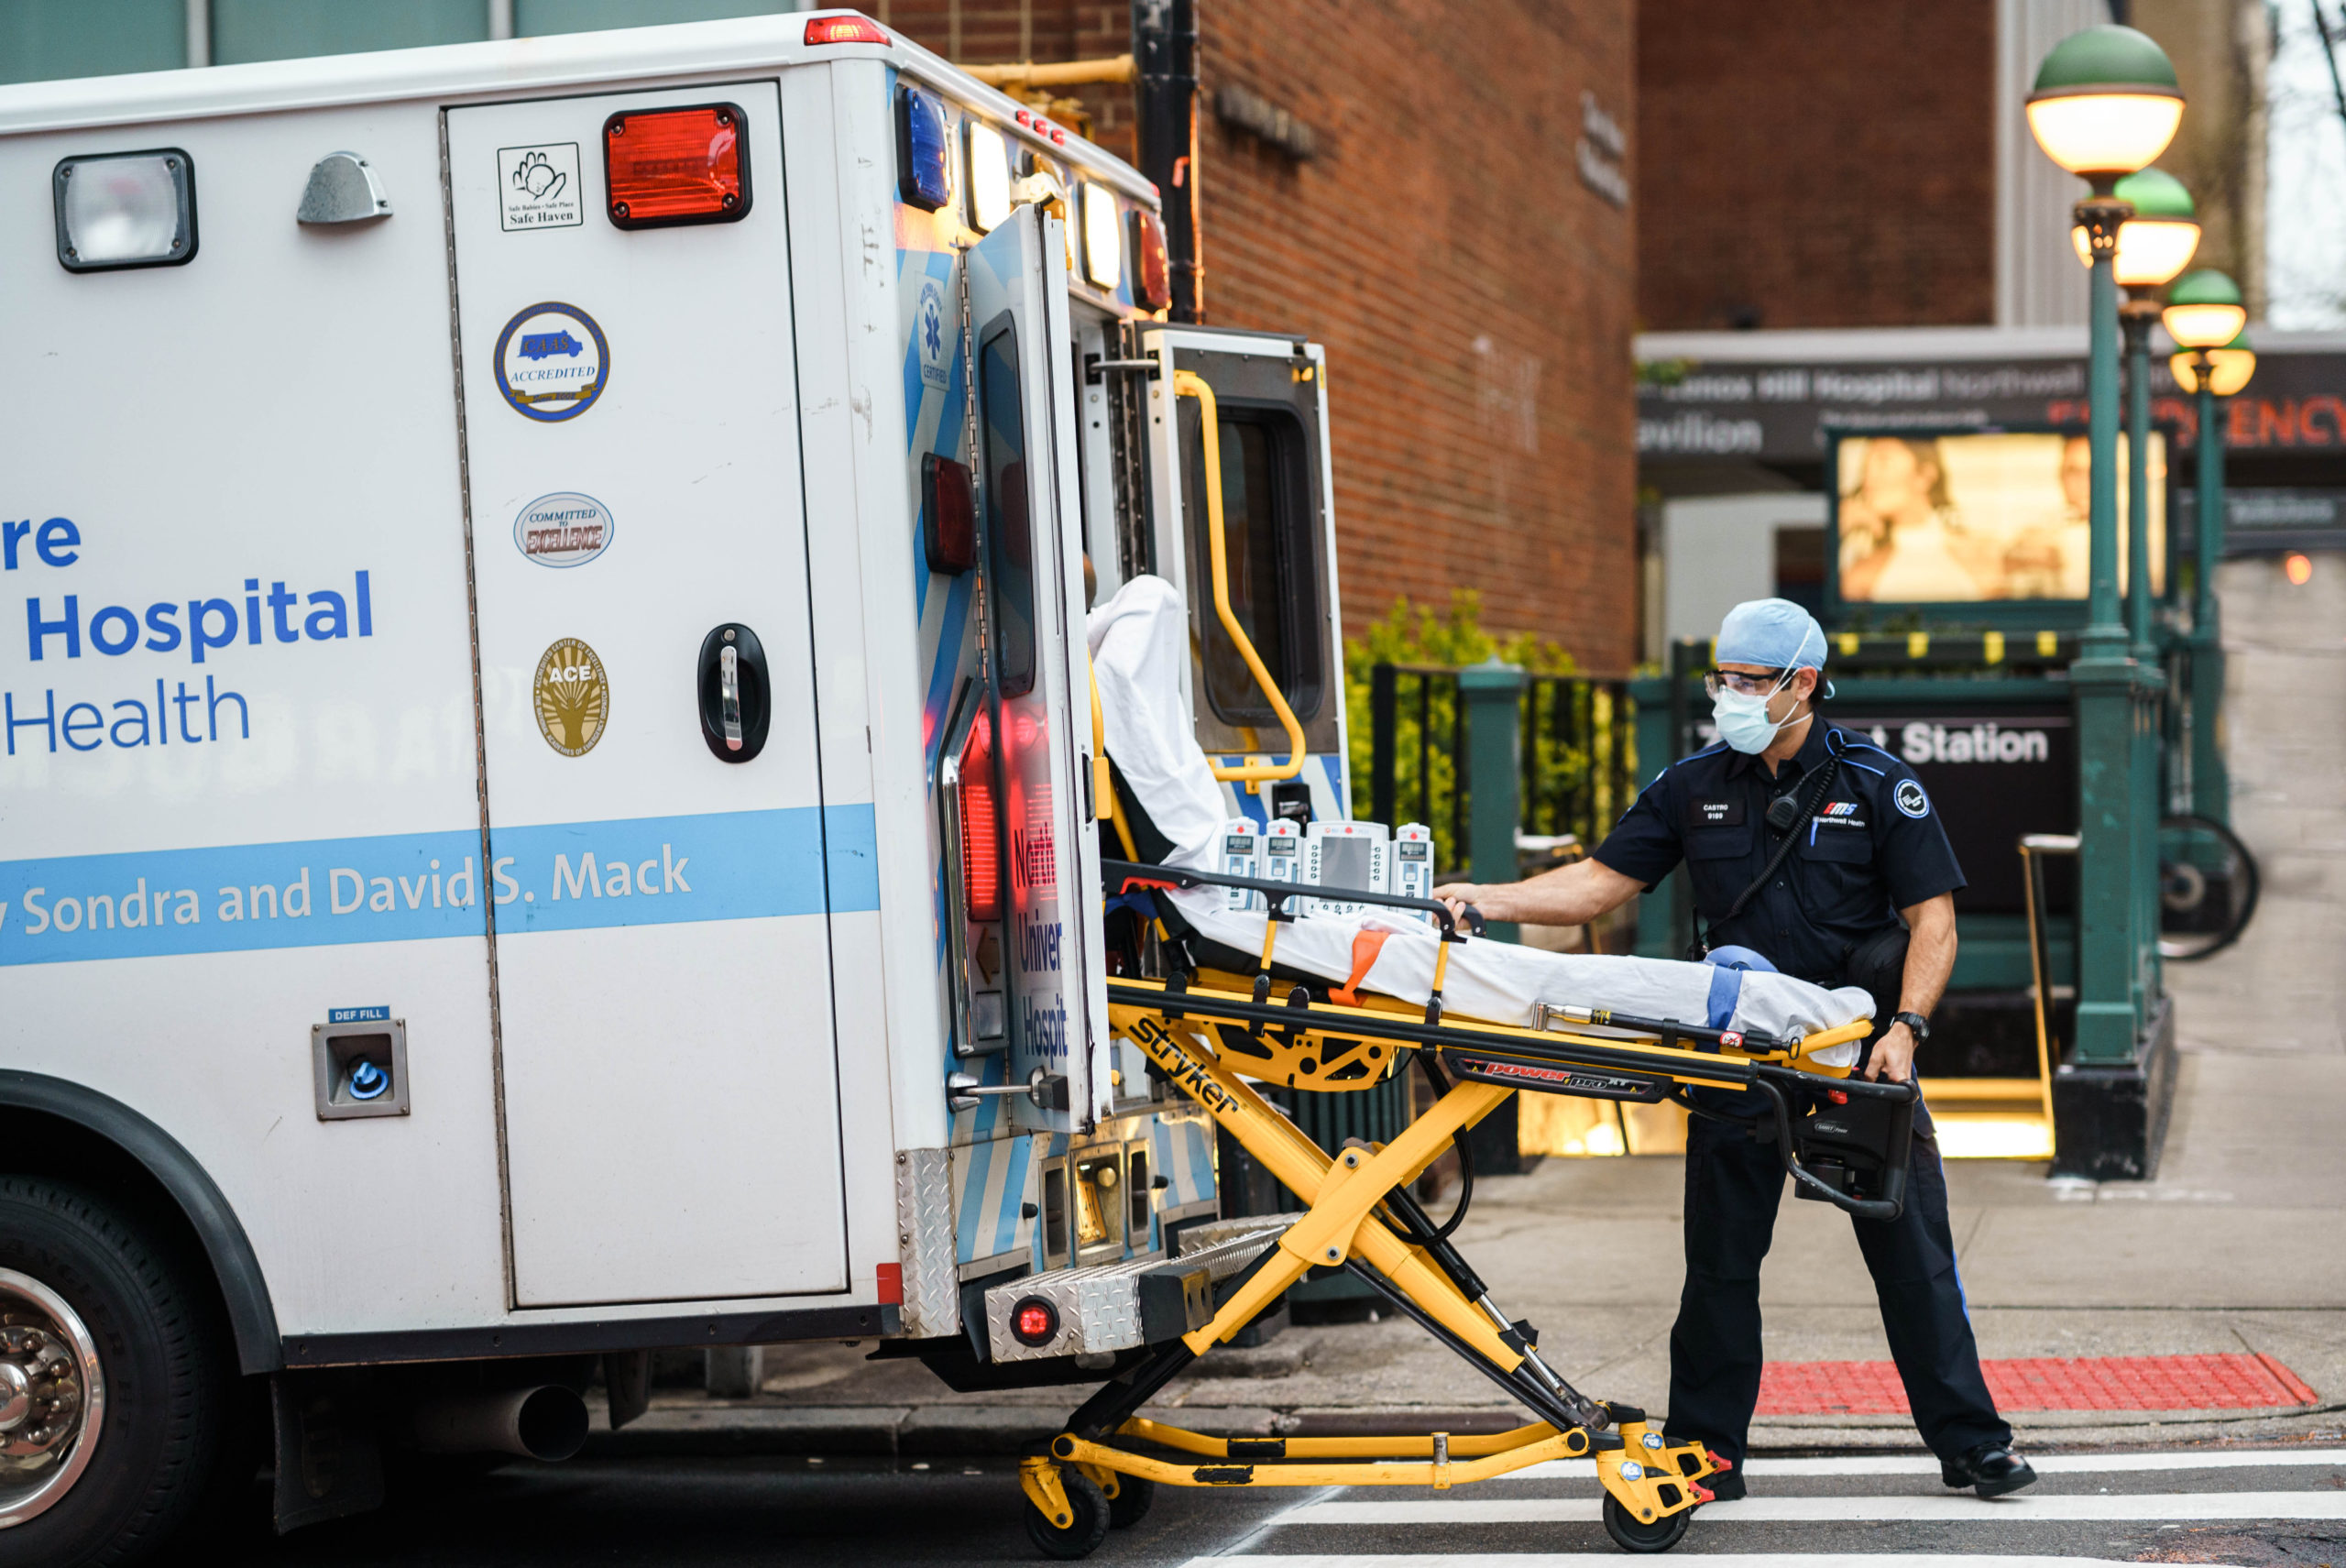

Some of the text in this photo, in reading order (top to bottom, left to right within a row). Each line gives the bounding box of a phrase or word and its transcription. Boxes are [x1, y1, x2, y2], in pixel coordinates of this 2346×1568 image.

[510, 212, 574, 225] Safe Haven
[524, 336, 569, 353] CAAS
[510, 367, 595, 382] ACCREDITED
[924, 364, 947, 384] CERTIFIED
[529, 509, 597, 523] COMMITTED
[2, 517, 81, 570] re
[526, 525, 602, 554] EXCELLENCE
[27, 570, 372, 663] Hospital
[549, 665, 592, 684] ACE
[5, 674, 249, 755] Health
[1902, 721, 2048, 764] Station
[1014, 821, 1056, 888] North
[23, 877, 201, 935] Sondra
[218, 866, 312, 920] and
[329, 856, 476, 916] David
[492, 856, 535, 905] S.
[552, 843, 693, 902] Mack
[1018, 908, 1062, 973] Univer
[334, 1008, 382, 1021] DEF FILL
[1023, 992, 1068, 1070] Hospit
[1128, 1017, 1239, 1114] stryker
[1484, 1061, 1572, 1083] power
[1569, 1076, 1608, 1091] pro
